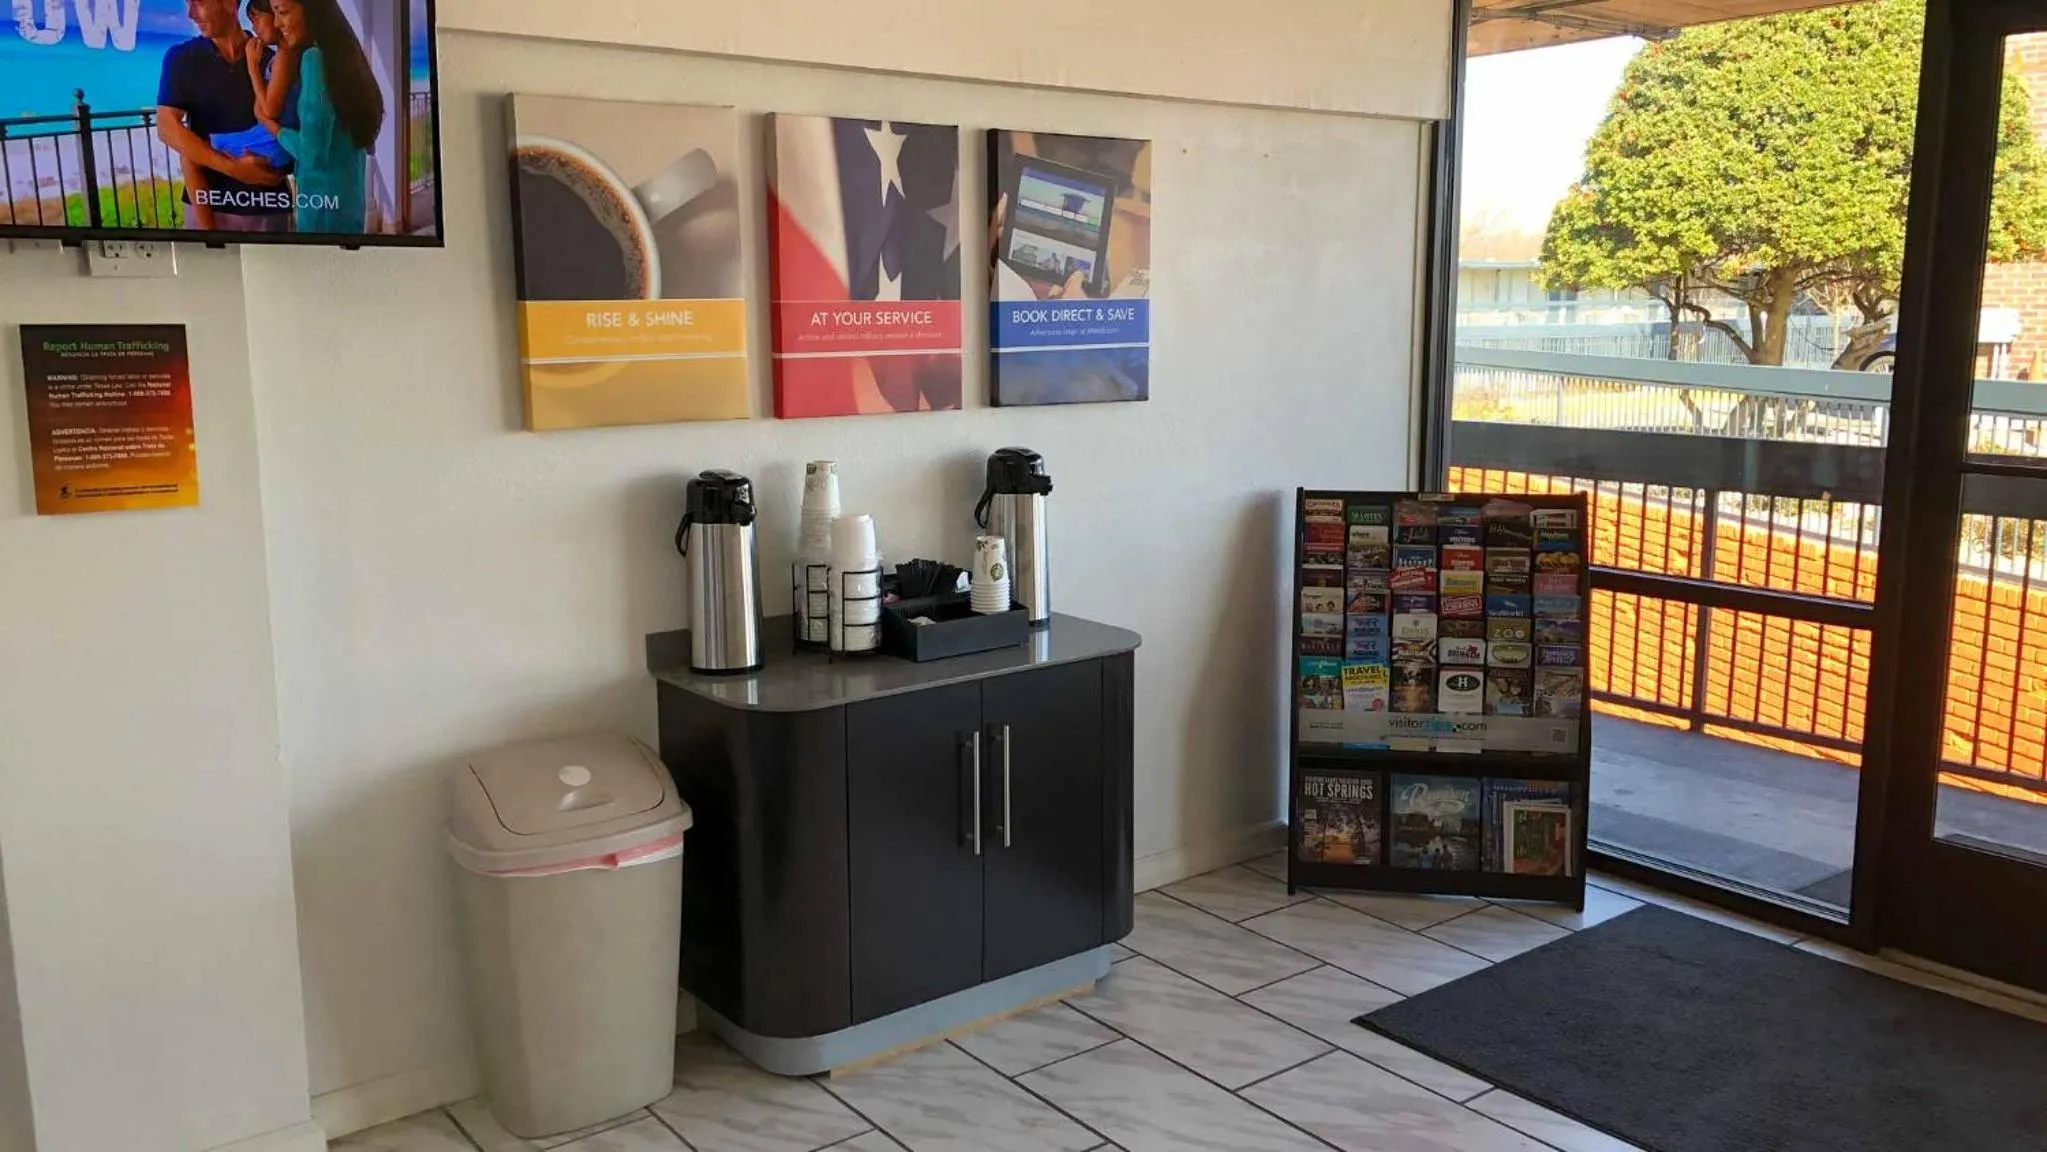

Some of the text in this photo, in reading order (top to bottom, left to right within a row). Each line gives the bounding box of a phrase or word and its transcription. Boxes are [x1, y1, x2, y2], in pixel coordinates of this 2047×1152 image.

[196, 190, 339, 210] BEACHES.COM
[586, 311, 694, 328] RISE & SHINE
[811, 310, 933, 327] AT YOUR SERVICE
[1012, 308, 1135, 323] BOOK DIRECT & SAVE
[43, 341, 170, 353] Report Human Trafficking
[1304, 779, 1325, 797] HOT
[1327, 782, 1374, 800] SPRINGS
